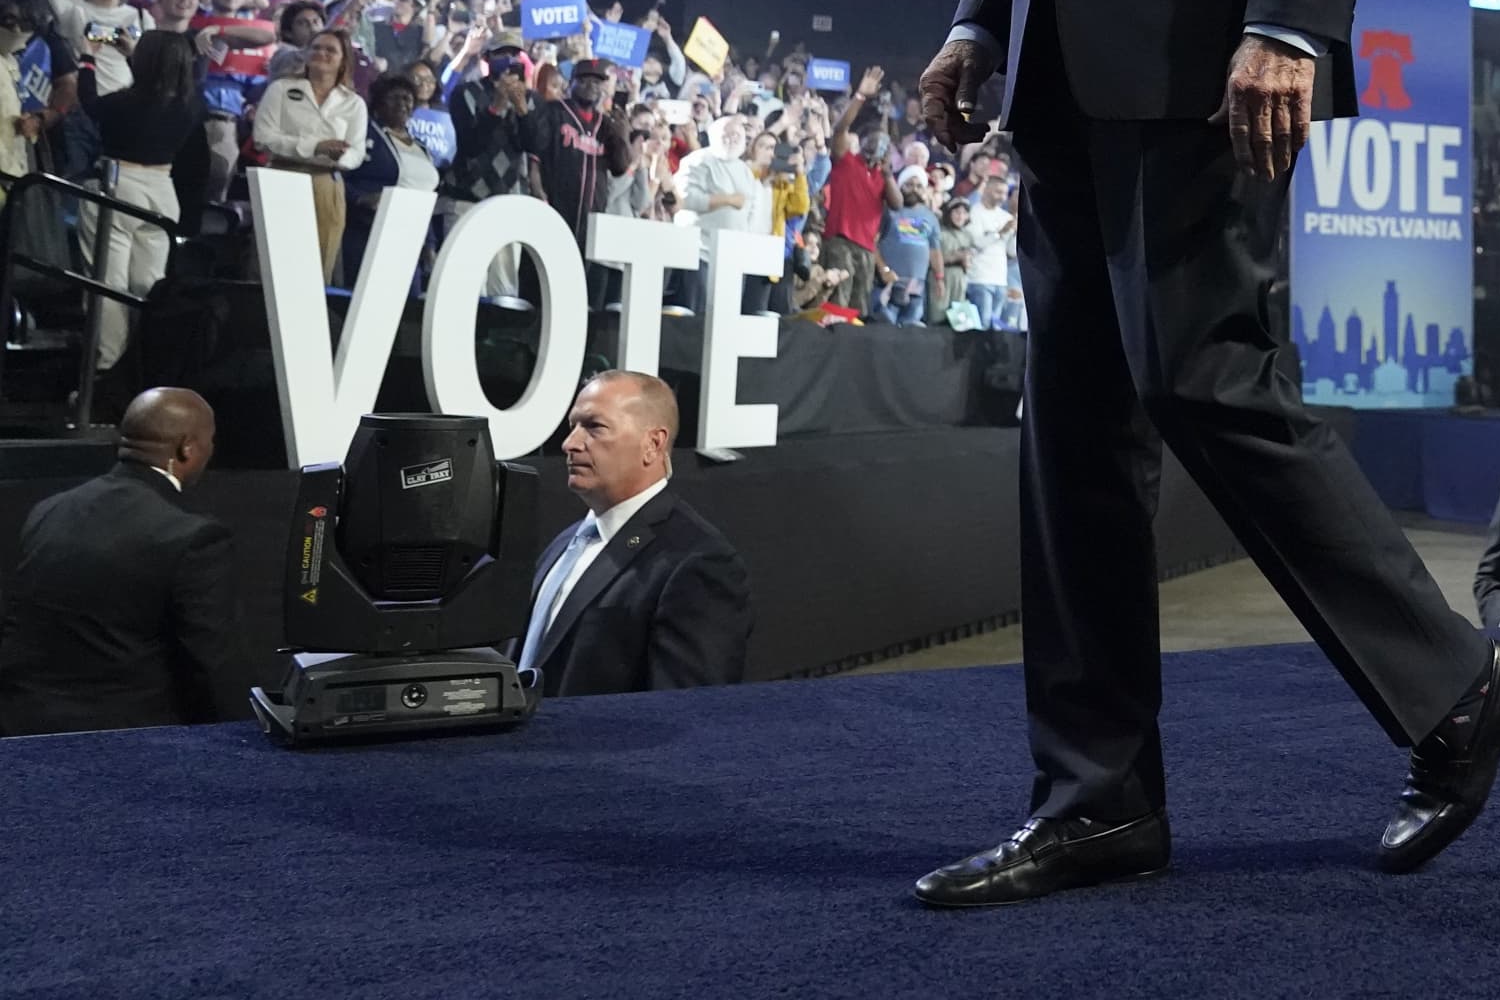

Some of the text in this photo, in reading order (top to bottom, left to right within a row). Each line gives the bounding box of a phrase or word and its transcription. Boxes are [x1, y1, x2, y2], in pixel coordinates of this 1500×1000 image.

[531, 4, 578, 25] VOTE!
[1309, 119, 1462, 215] VOTE
[1305, 211, 1462, 241] PENNSYLVANIA
[246, 166, 785, 470] VOTE
[302, 536, 312, 569] CAUTION
